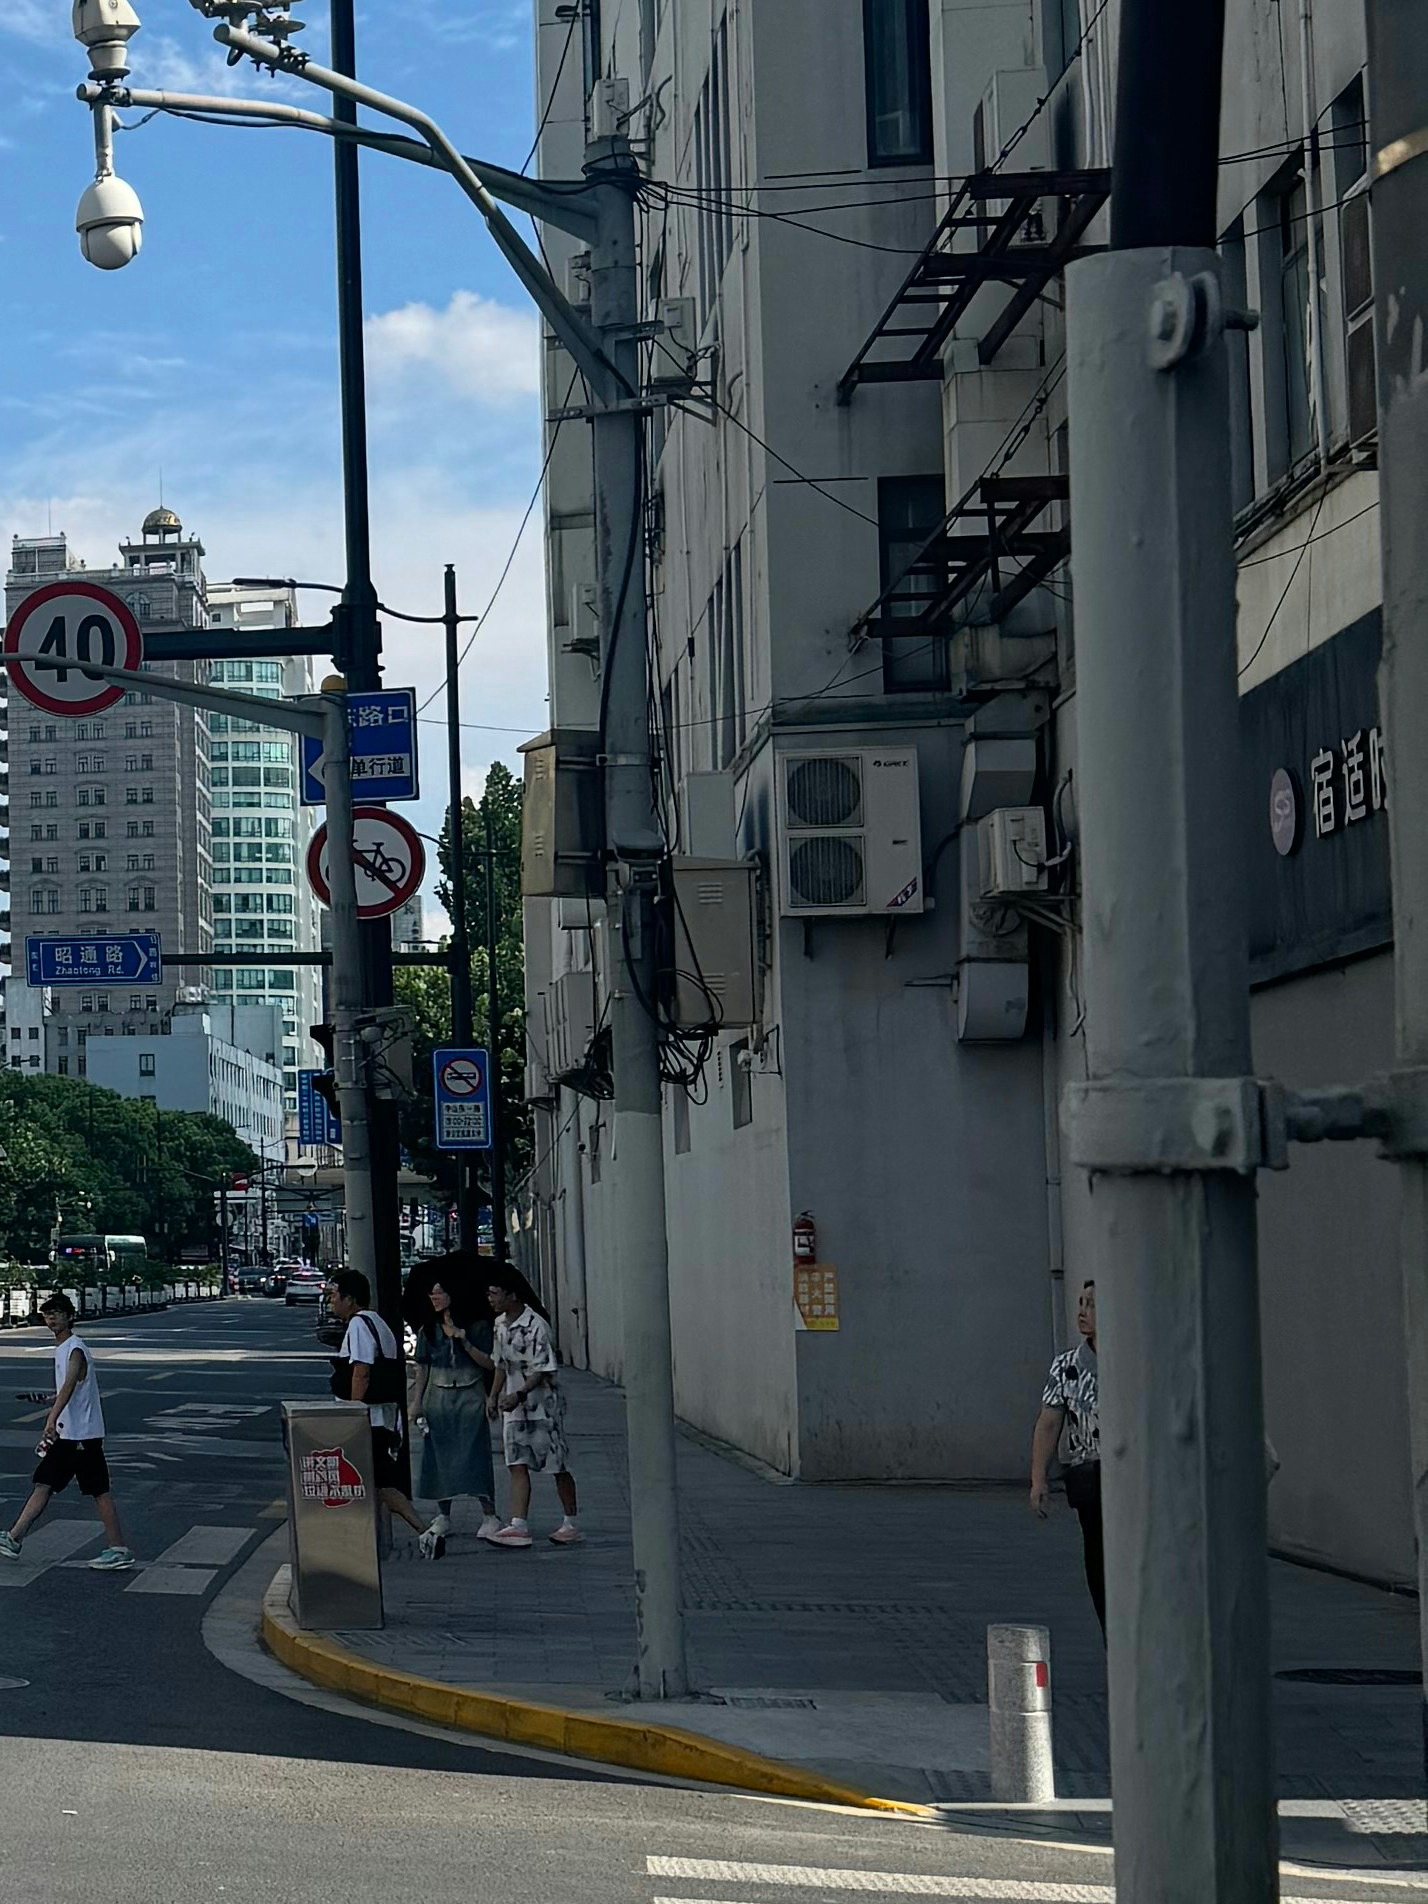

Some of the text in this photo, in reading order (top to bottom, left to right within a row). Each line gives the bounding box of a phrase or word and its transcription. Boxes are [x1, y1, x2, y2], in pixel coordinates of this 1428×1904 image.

[34, 614, 115, 683] 40
[55, 945, 124, 964] 昭通路
[55, 966, 101, 976] Zhaotong
